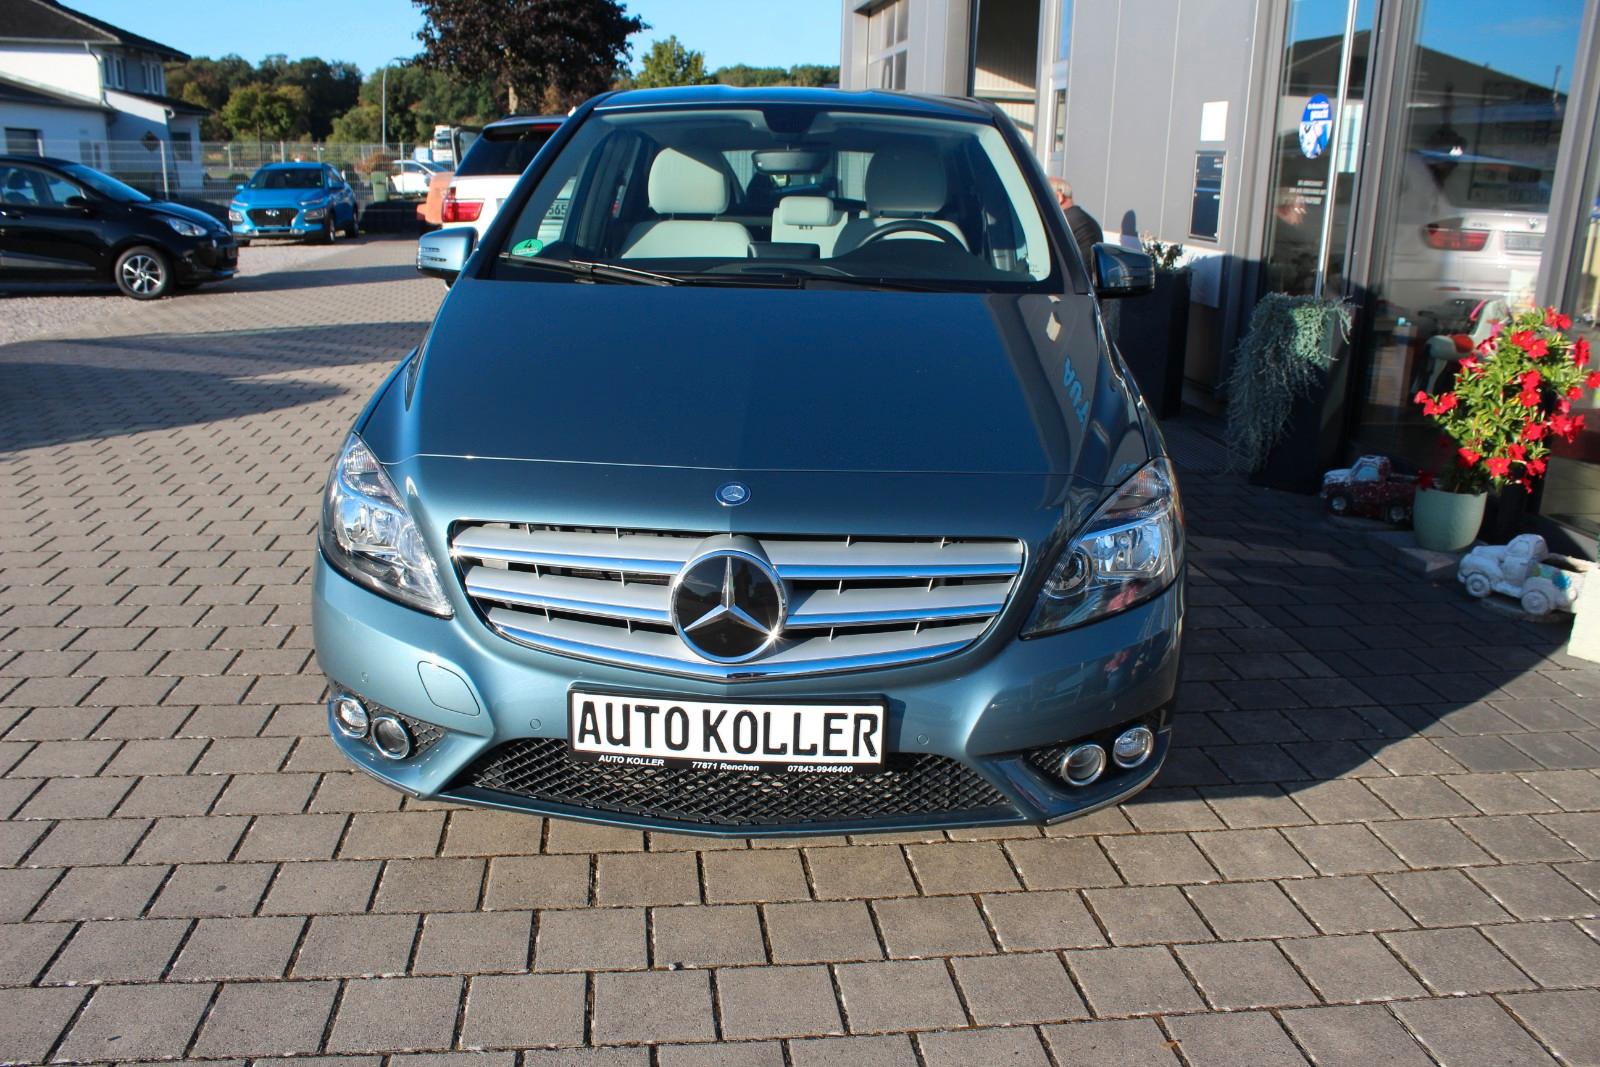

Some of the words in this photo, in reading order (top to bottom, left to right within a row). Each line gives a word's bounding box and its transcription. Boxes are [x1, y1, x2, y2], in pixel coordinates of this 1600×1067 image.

[578, 701, 690, 751] AUTO
[702, 709, 879, 758] KOLLER
[598, 754, 625, 764] AUTO
[626, 757, 665, 767] KOLLER
[691, 761, 718, 770] 77871
[720, 763, 760, 772] Renchen
[787, 765, 854, 773] 07843-9946400
